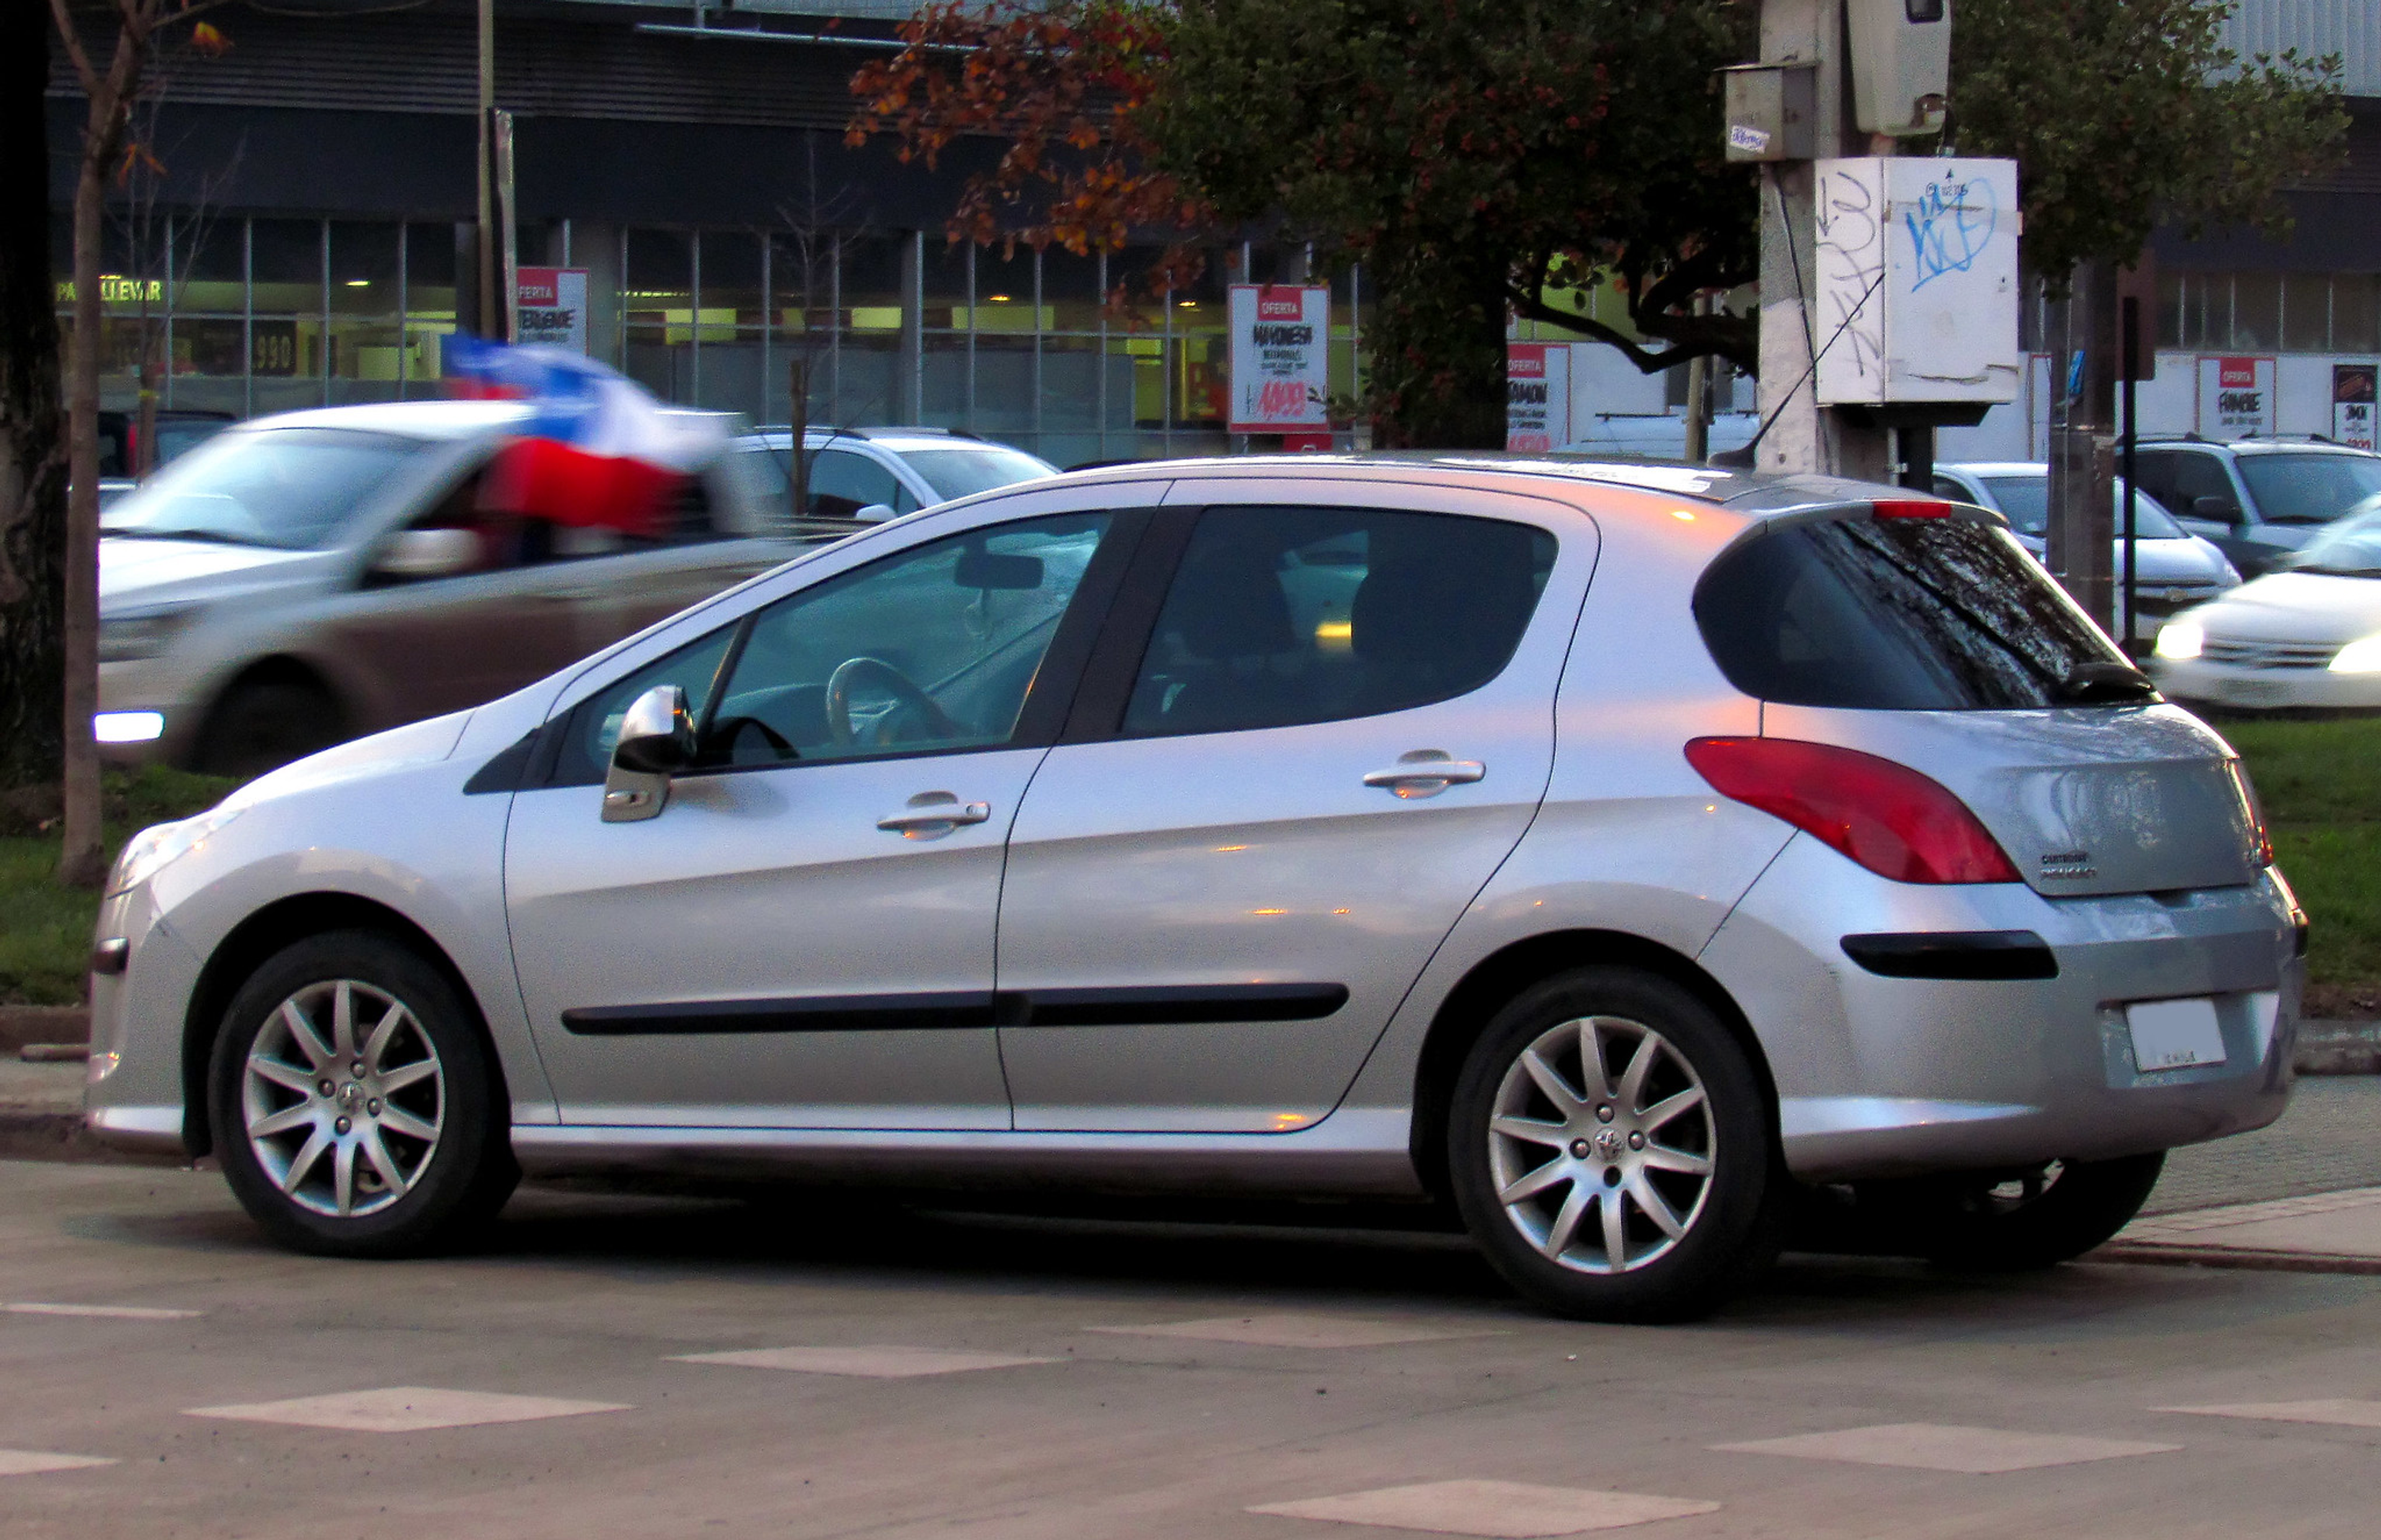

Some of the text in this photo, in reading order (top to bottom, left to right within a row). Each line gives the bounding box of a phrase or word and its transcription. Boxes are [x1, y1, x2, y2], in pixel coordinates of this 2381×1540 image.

[518, 286, 553, 299] FERTA
[1262, 303, 1298, 315] OFERTA
[2223, 371, 2251, 383] OFERTA
